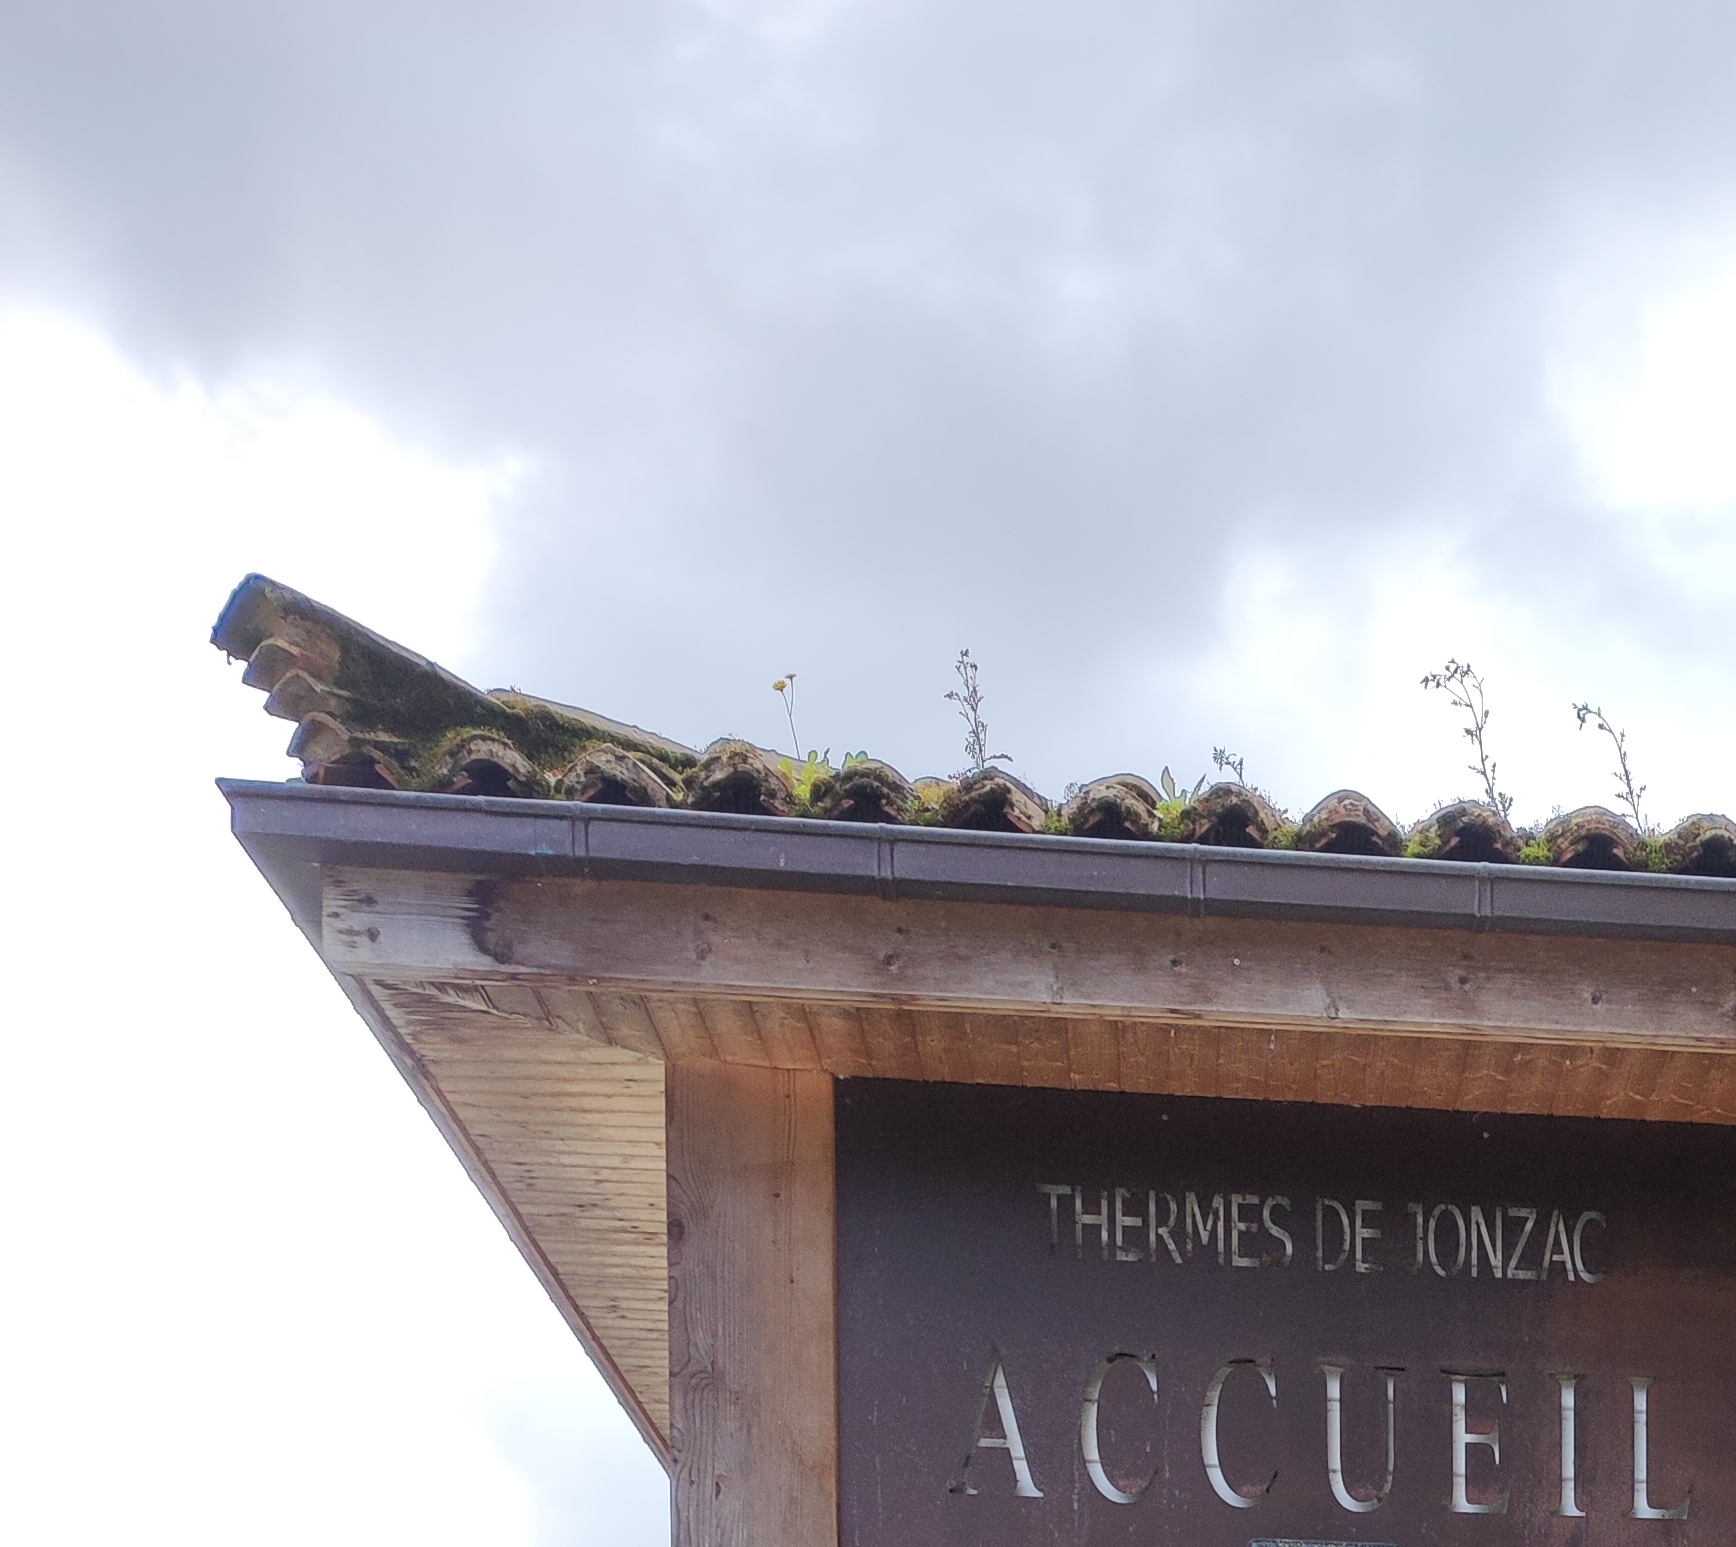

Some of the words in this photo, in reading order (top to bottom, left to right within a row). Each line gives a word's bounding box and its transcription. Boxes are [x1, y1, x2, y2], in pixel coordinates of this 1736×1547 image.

[1035, 1182, 1293, 1267] THERMES
[1314, 1198, 1384, 1273] DE
[1407, 1202, 1607, 1284] JONZAC
[948, 1352, 1691, 1520] ACCUEIL
